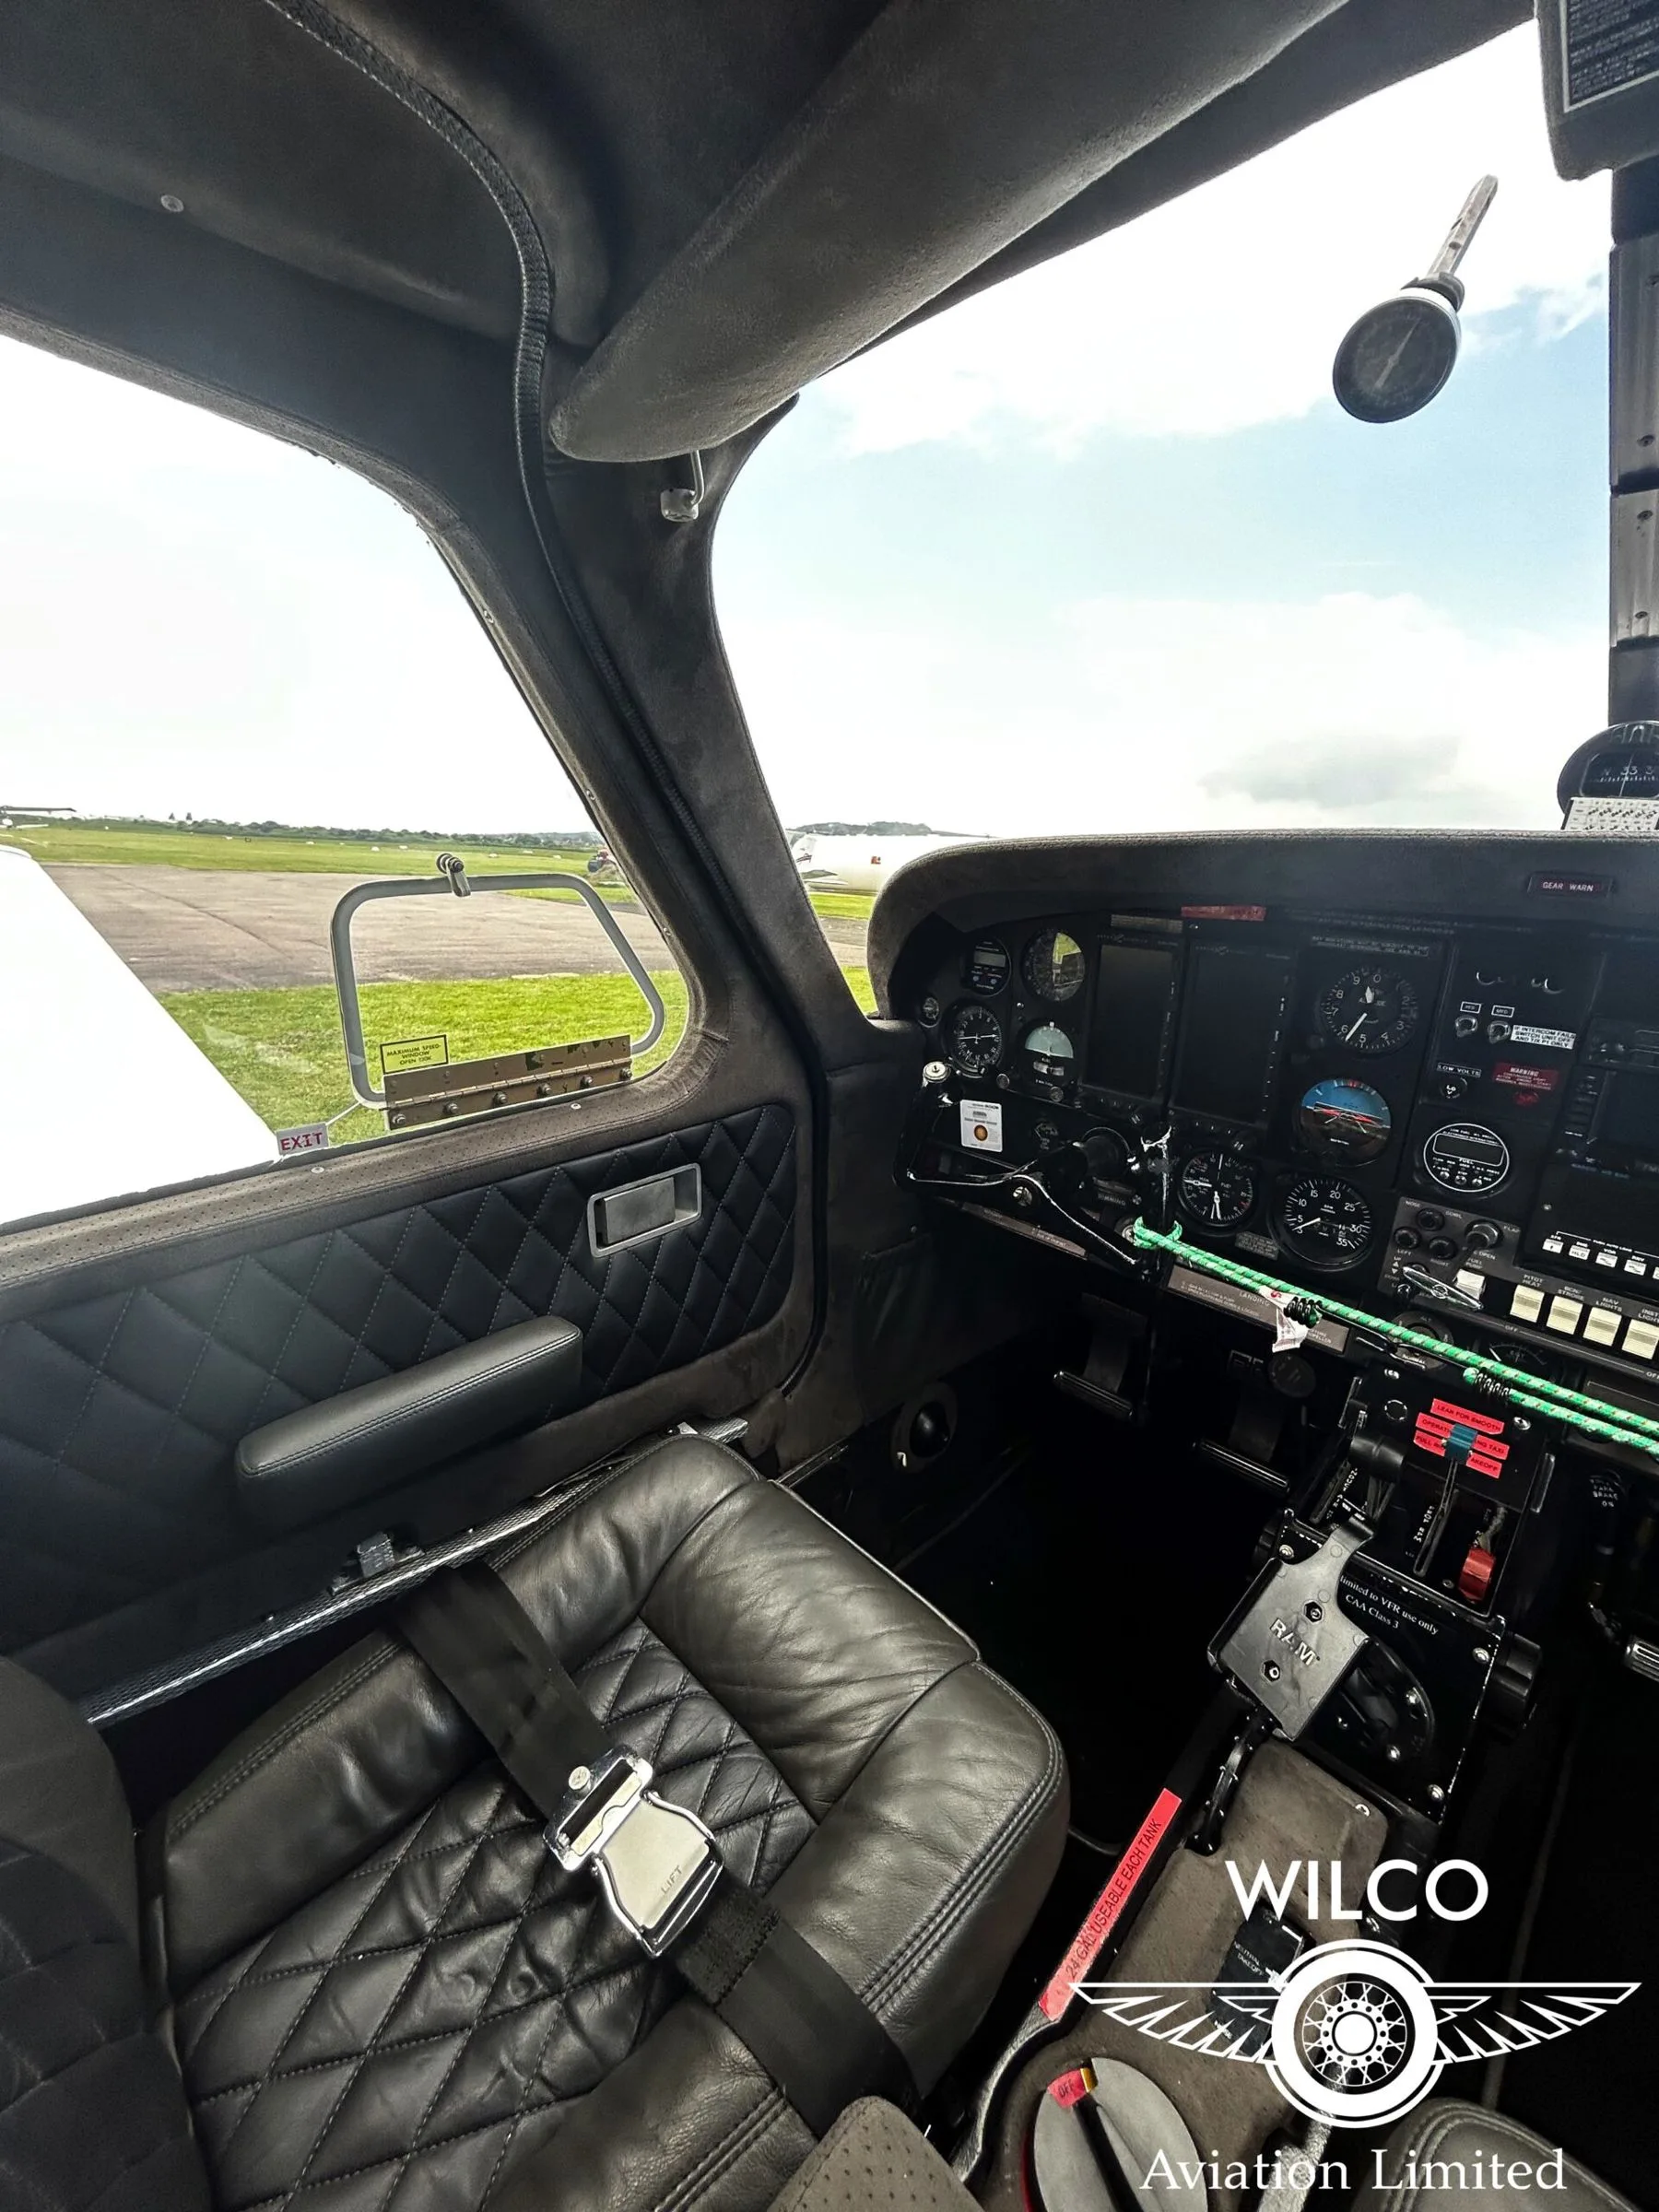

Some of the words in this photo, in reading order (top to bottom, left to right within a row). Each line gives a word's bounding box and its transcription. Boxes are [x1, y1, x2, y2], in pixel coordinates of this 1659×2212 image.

[1542, 881, 1564, 890] GEAR
[1569, 883, 1594, 892] WARN
[386, 1046, 420, 1057] MAXIMUM
[401, 1051, 430, 1059] WINDOW
[1510, 1066, 1539, 1077] WARNING
[280, 1132, 323, 1151] EXIT
[1310, 1189, 1319, 1198] 15
[1329, 1190, 1341, 1199] 20
[1298, 1198, 1307, 1207] 10
[1344, 1202, 1356, 1212] 25
[1349, 1223, 1362, 1234] 30
[1336, 1238, 1348, 1247] 35
[1239, 1290, 1270, 1307] LANDING
[1602, 1297, 1619, 1305] NAV
[1595, 1300, 1622, 1312] LIGHTS
[1638, 1312, 1659, 1324] LIGHT
[1504, 1324, 1519, 1333] OFF
[1422, 1418, 1450, 1432] OPERAT
[1455, 1411, 1470, 1420] FOR
[1471, 1417, 1501, 1431] SMOOTH
[1471, 1456, 1499, 1471] AKEOFF
[1339, 1574, 1370, 1596] limited
[1370, 1592, 1379, 1602] to
[1381, 1596, 1401, 1615] VFR
[1402, 1611, 1418, 1623] use
[1418, 1619, 1440, 1635] only
[1345, 1594, 1367, 1612] CAA
[1368, 1606, 1392, 1626] Class
[1392, 1620, 1400, 1630] 3
[660, 1865, 683, 1896] LIFT
[1065, 1959, 1080, 1981] 24
[1076, 1932, 1096, 1961] GAL
[1089, 1879, 1128, 1935] USEABLE
[1121, 1848, 1147, 1882] EACH
[1137, 1819, 1162, 1852] TANK
[1233, 1942, 1261, 1966] NEUTRAL
[1058, 2078, 1075, 2098] OFF
